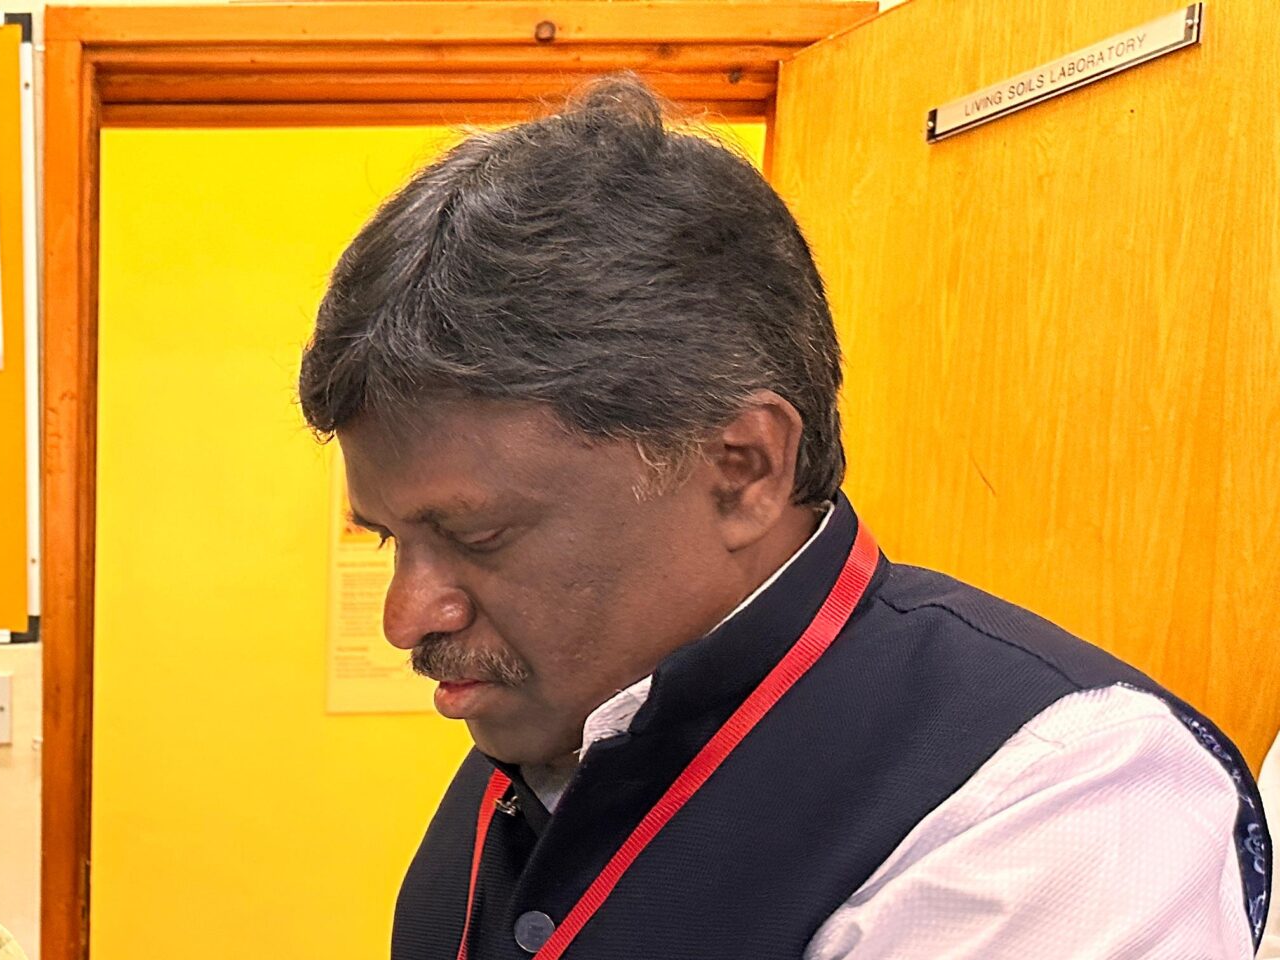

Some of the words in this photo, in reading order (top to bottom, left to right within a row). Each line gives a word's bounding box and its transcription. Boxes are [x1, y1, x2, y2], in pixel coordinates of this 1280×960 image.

[965, 91, 1003, 117] LIVING
[1008, 73, 1045, 101] SOILS
[1050, 33, 1147, 84] LABORATORY
